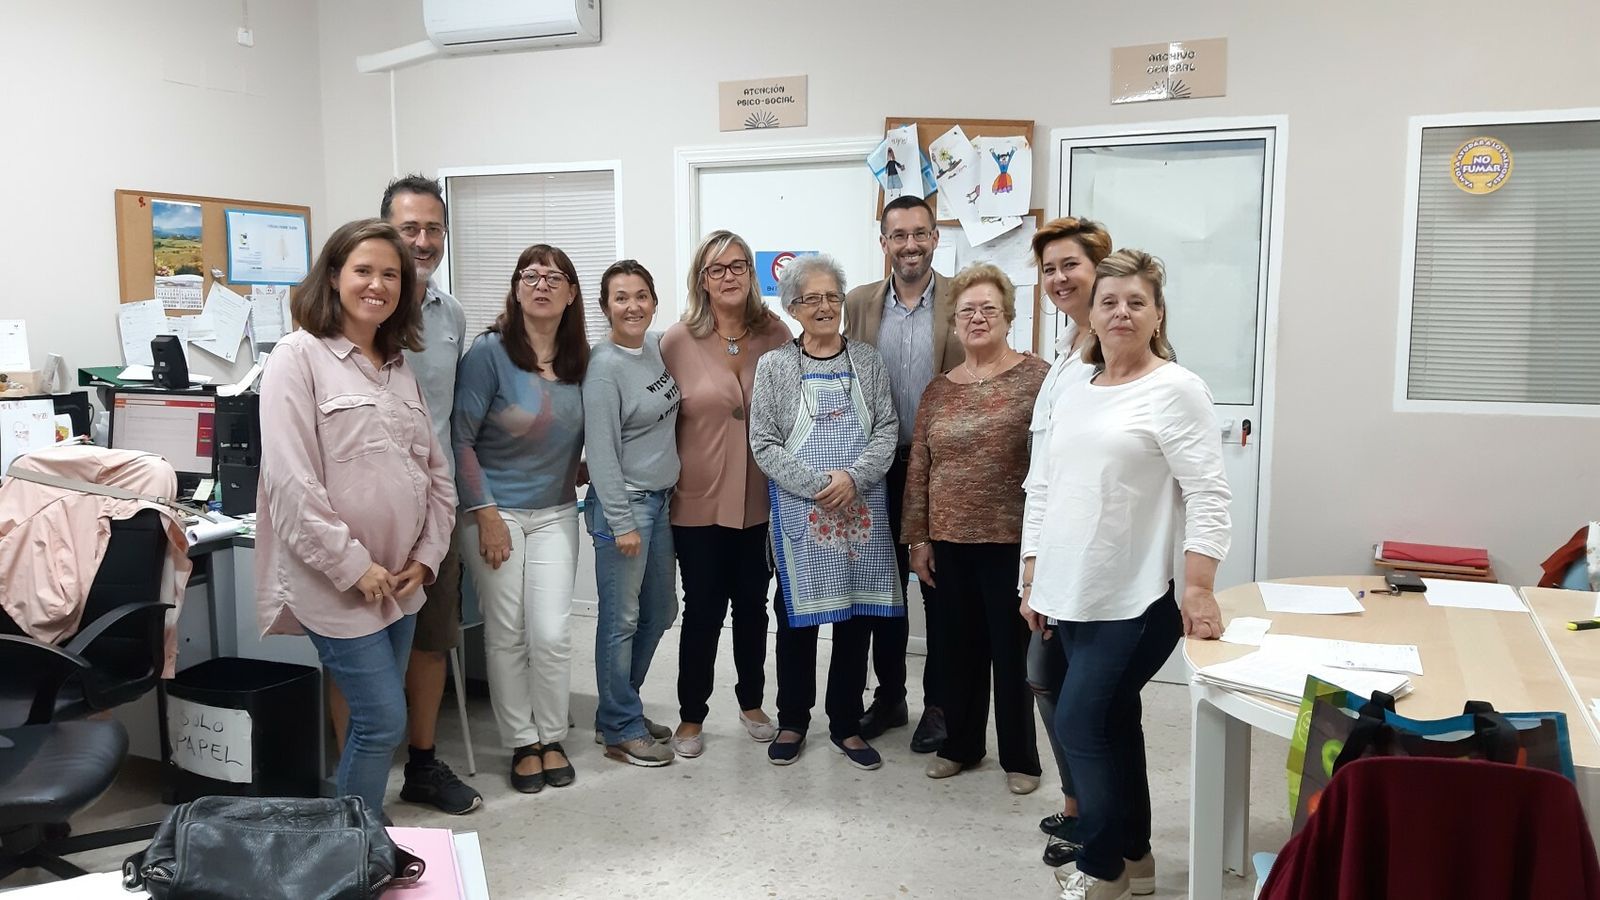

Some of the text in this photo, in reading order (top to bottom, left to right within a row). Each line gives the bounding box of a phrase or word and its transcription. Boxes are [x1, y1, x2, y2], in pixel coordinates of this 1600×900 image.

[1148, 51, 1195, 62] ARCHIVO
[1146, 63, 1196, 74] GENERAL
[743, 84, 785, 96] ATENCIÓN
[736, 96, 795, 106] PSICO-SOCIAL
[1473, 155, 1491, 164] NO
[1462, 165, 1501, 173] FUMAR
[180, 712, 224, 732] SOLO
[175, 734, 243, 766] PAPEL
